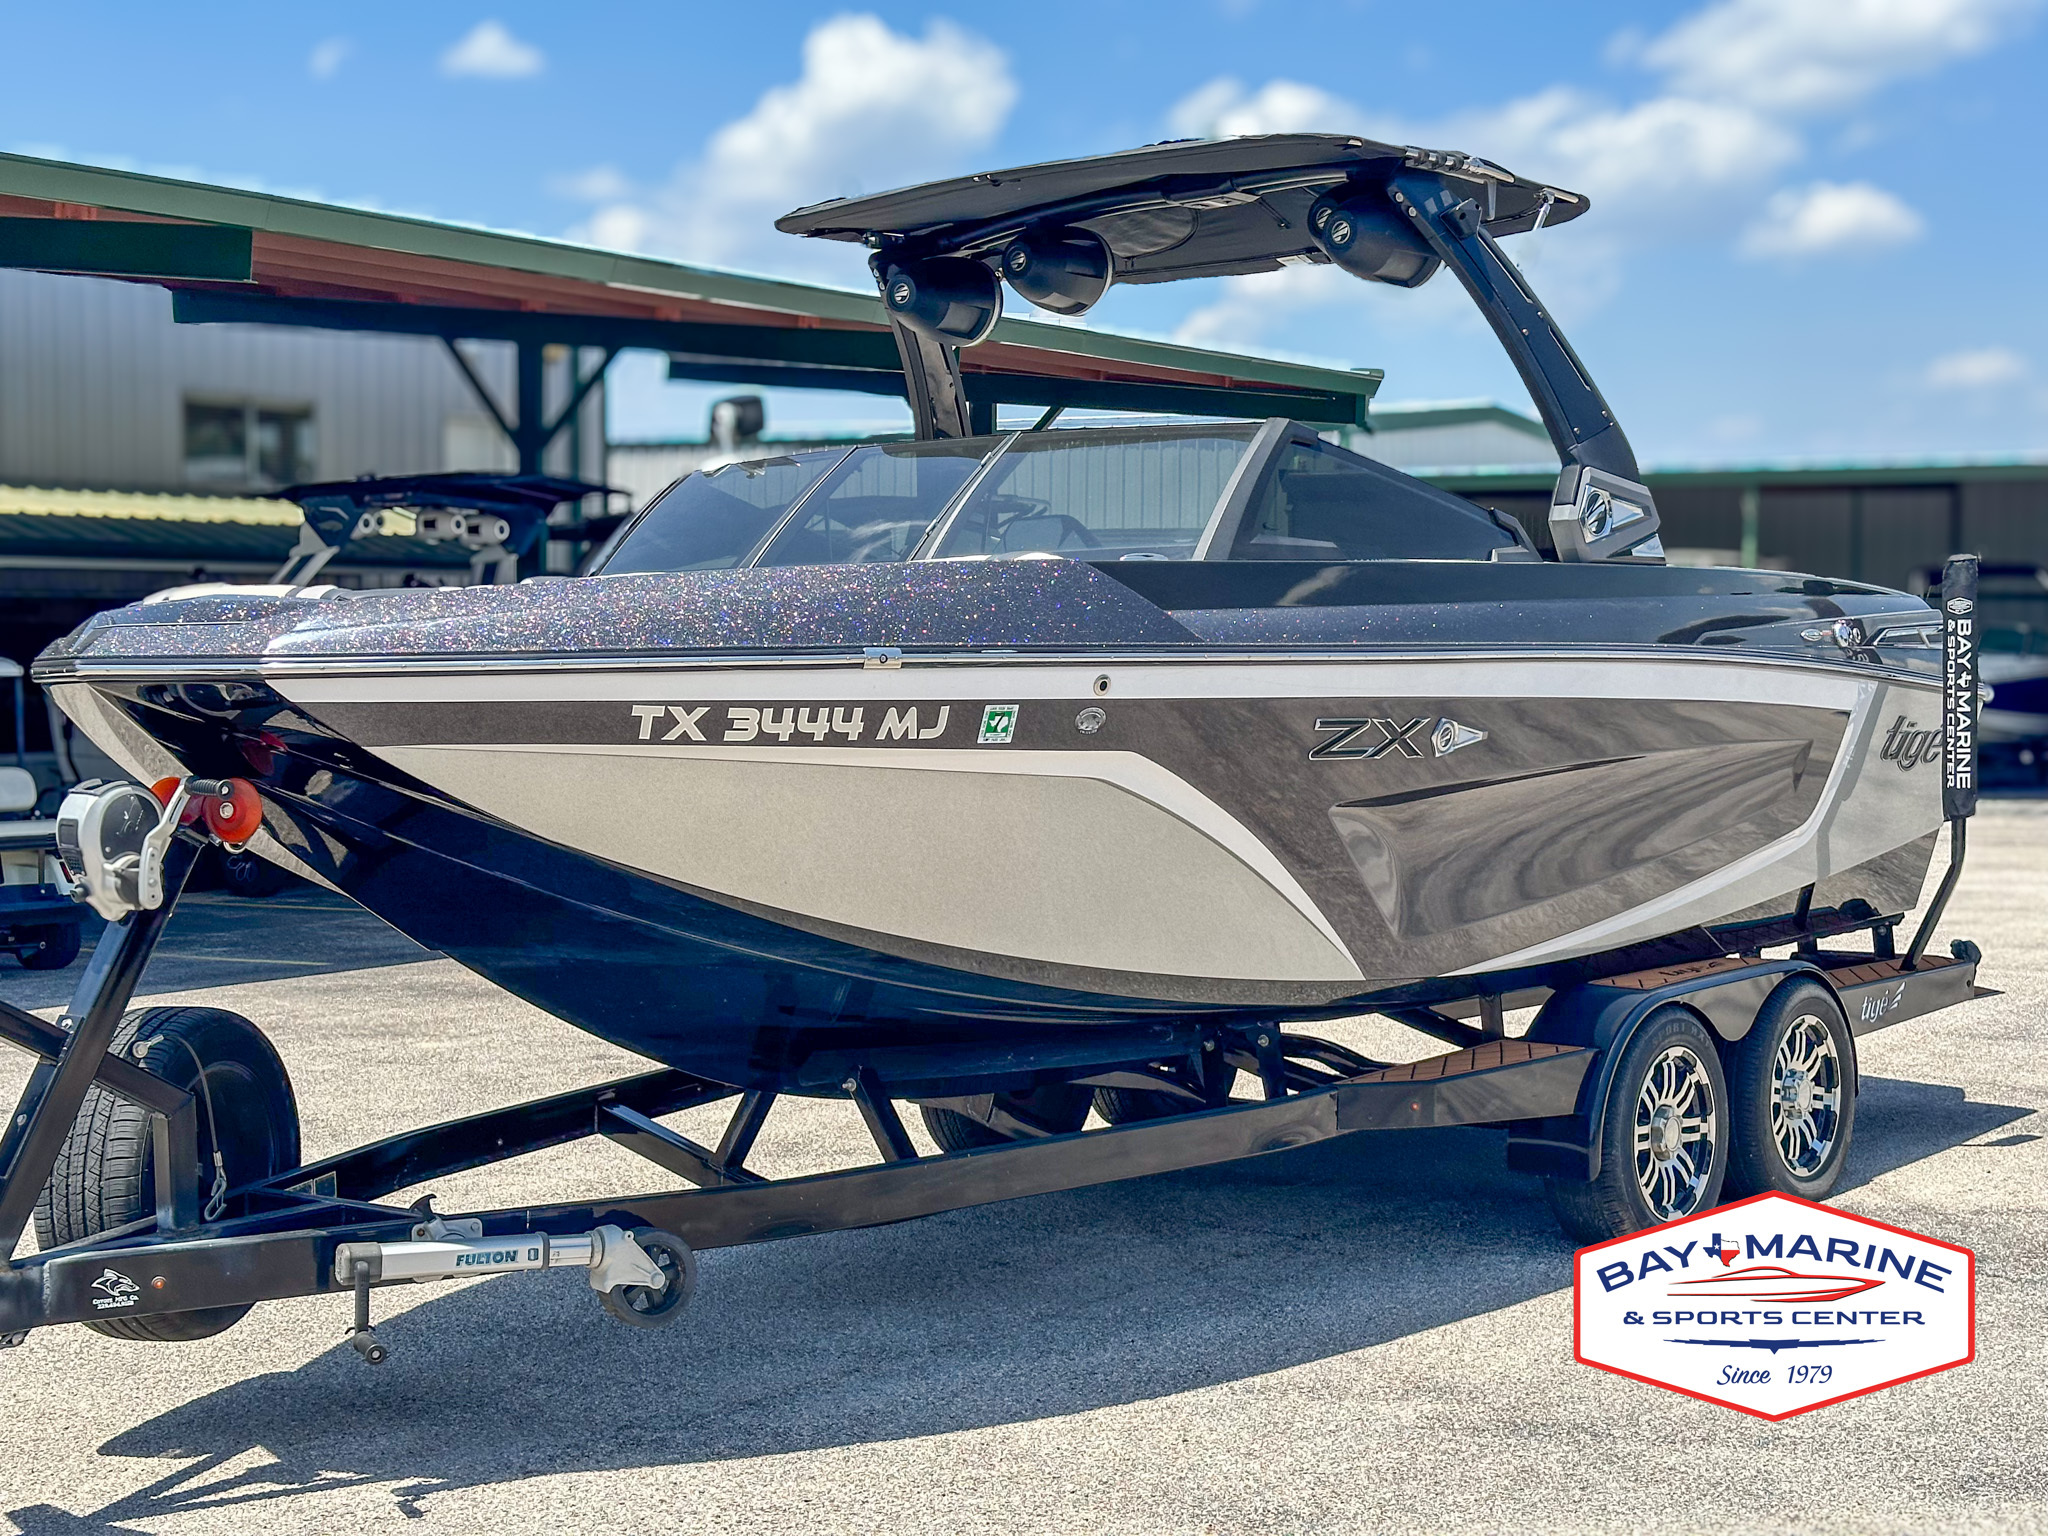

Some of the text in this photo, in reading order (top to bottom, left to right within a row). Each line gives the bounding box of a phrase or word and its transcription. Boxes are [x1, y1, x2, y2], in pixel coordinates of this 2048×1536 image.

[1956, 619, 1972, 669] BAY
[631, 704, 710, 741] TX
[723, 705, 864, 742] 3444
[876, 704, 950, 740] MJ
[1946, 619, 1956, 788] & SPORTS CENTER
[1308, 716, 1431, 760] ZX
[1956, 691, 1972, 789] MARINE
[456, 1249, 518, 1266] FULTON
